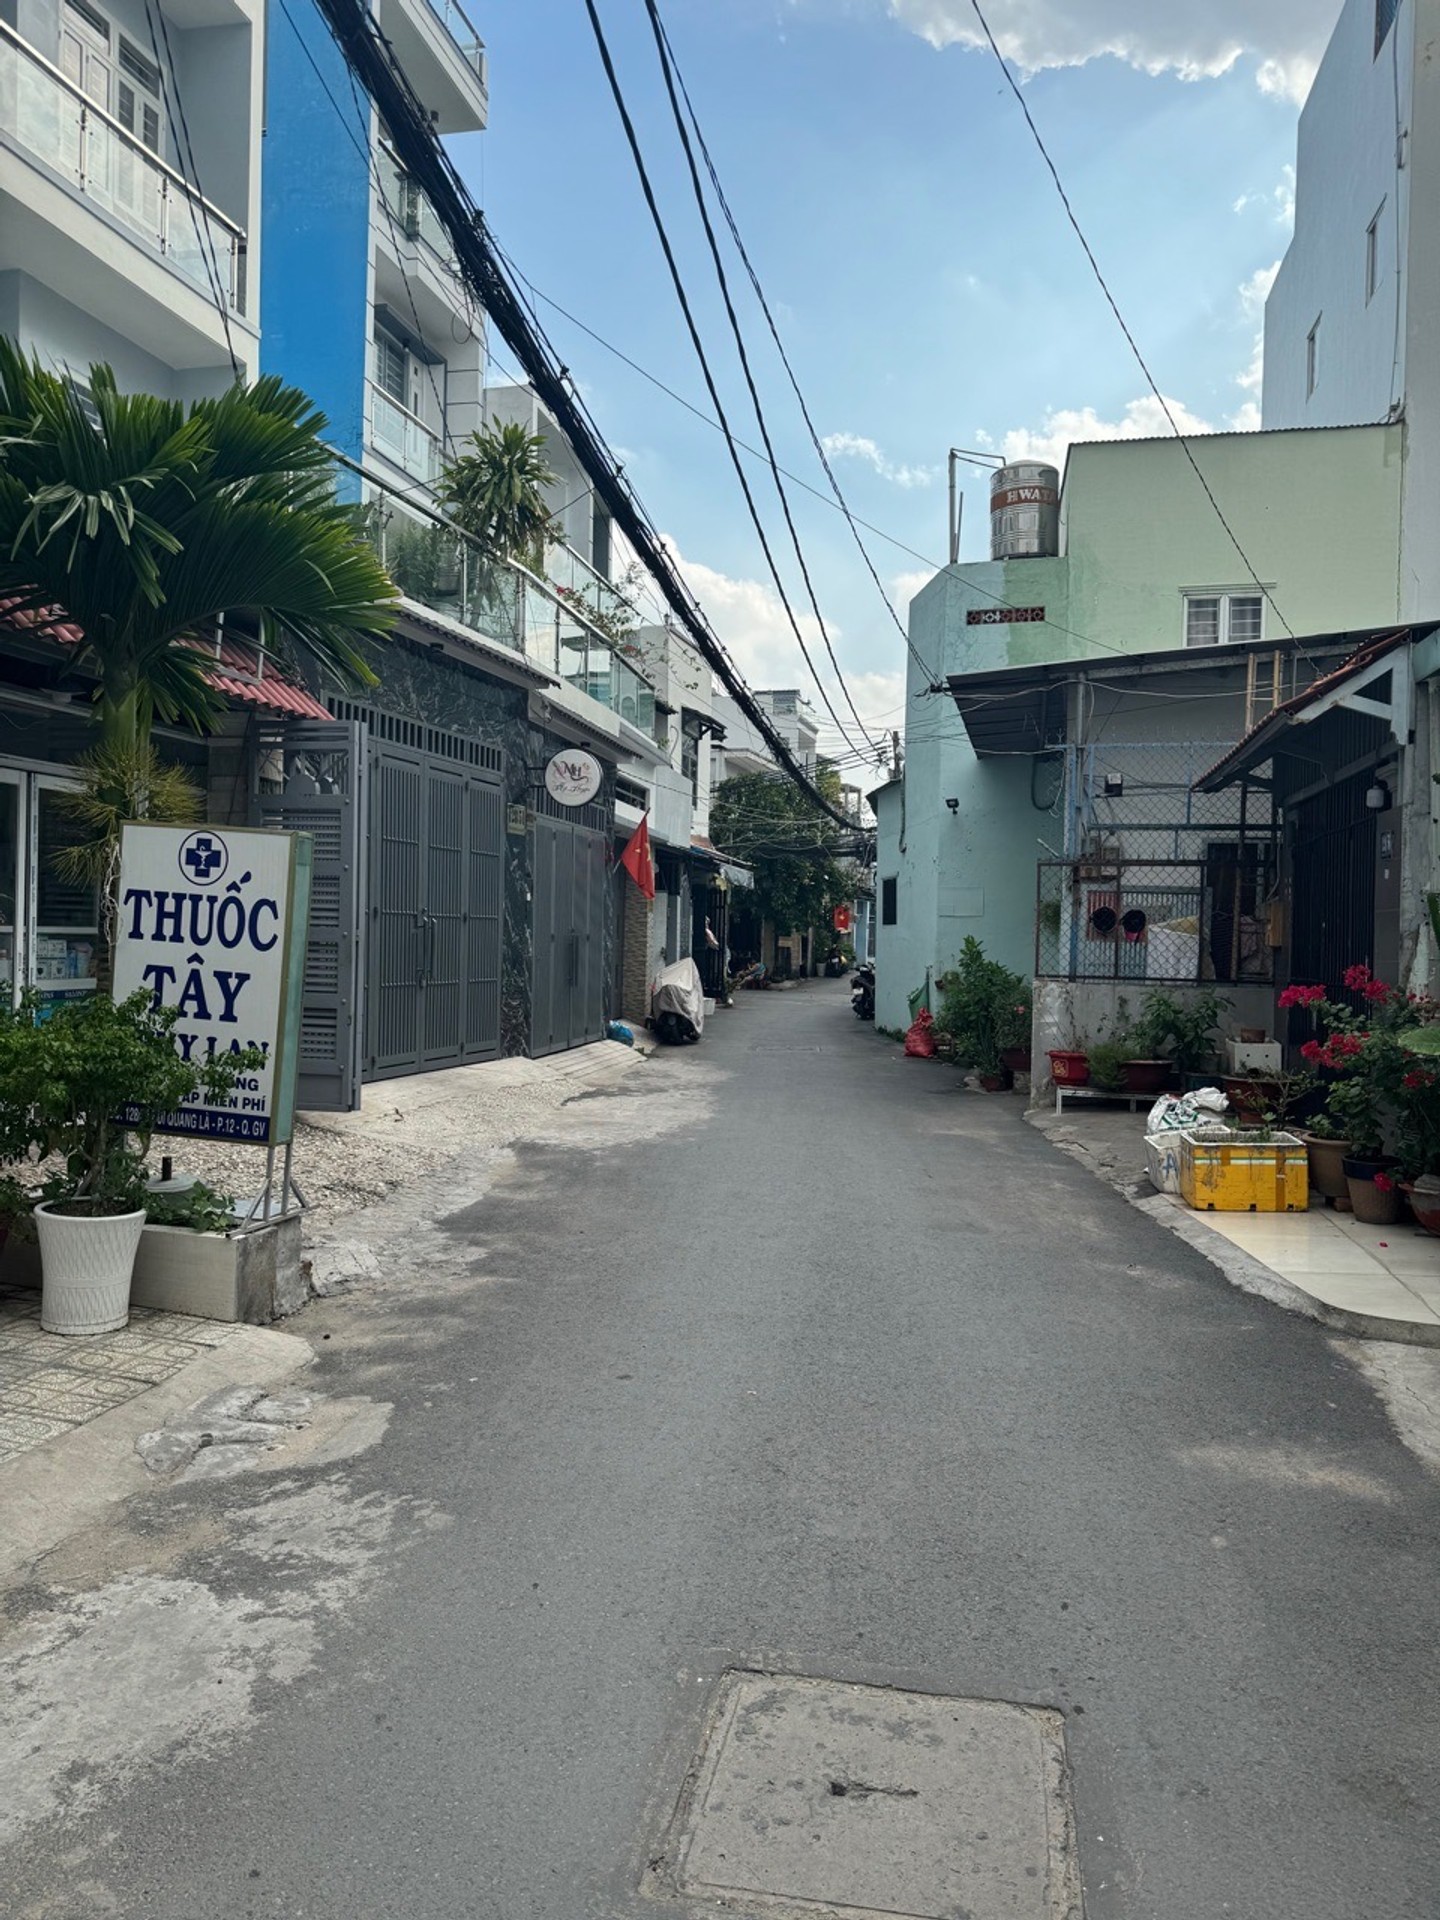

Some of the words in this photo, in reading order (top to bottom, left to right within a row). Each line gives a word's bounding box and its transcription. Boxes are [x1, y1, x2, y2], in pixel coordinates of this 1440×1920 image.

[123, 871, 279, 952] THUỐC
[142, 952, 251, 1023] TÂY
[242, 1095, 266, 1112] PHÍ
